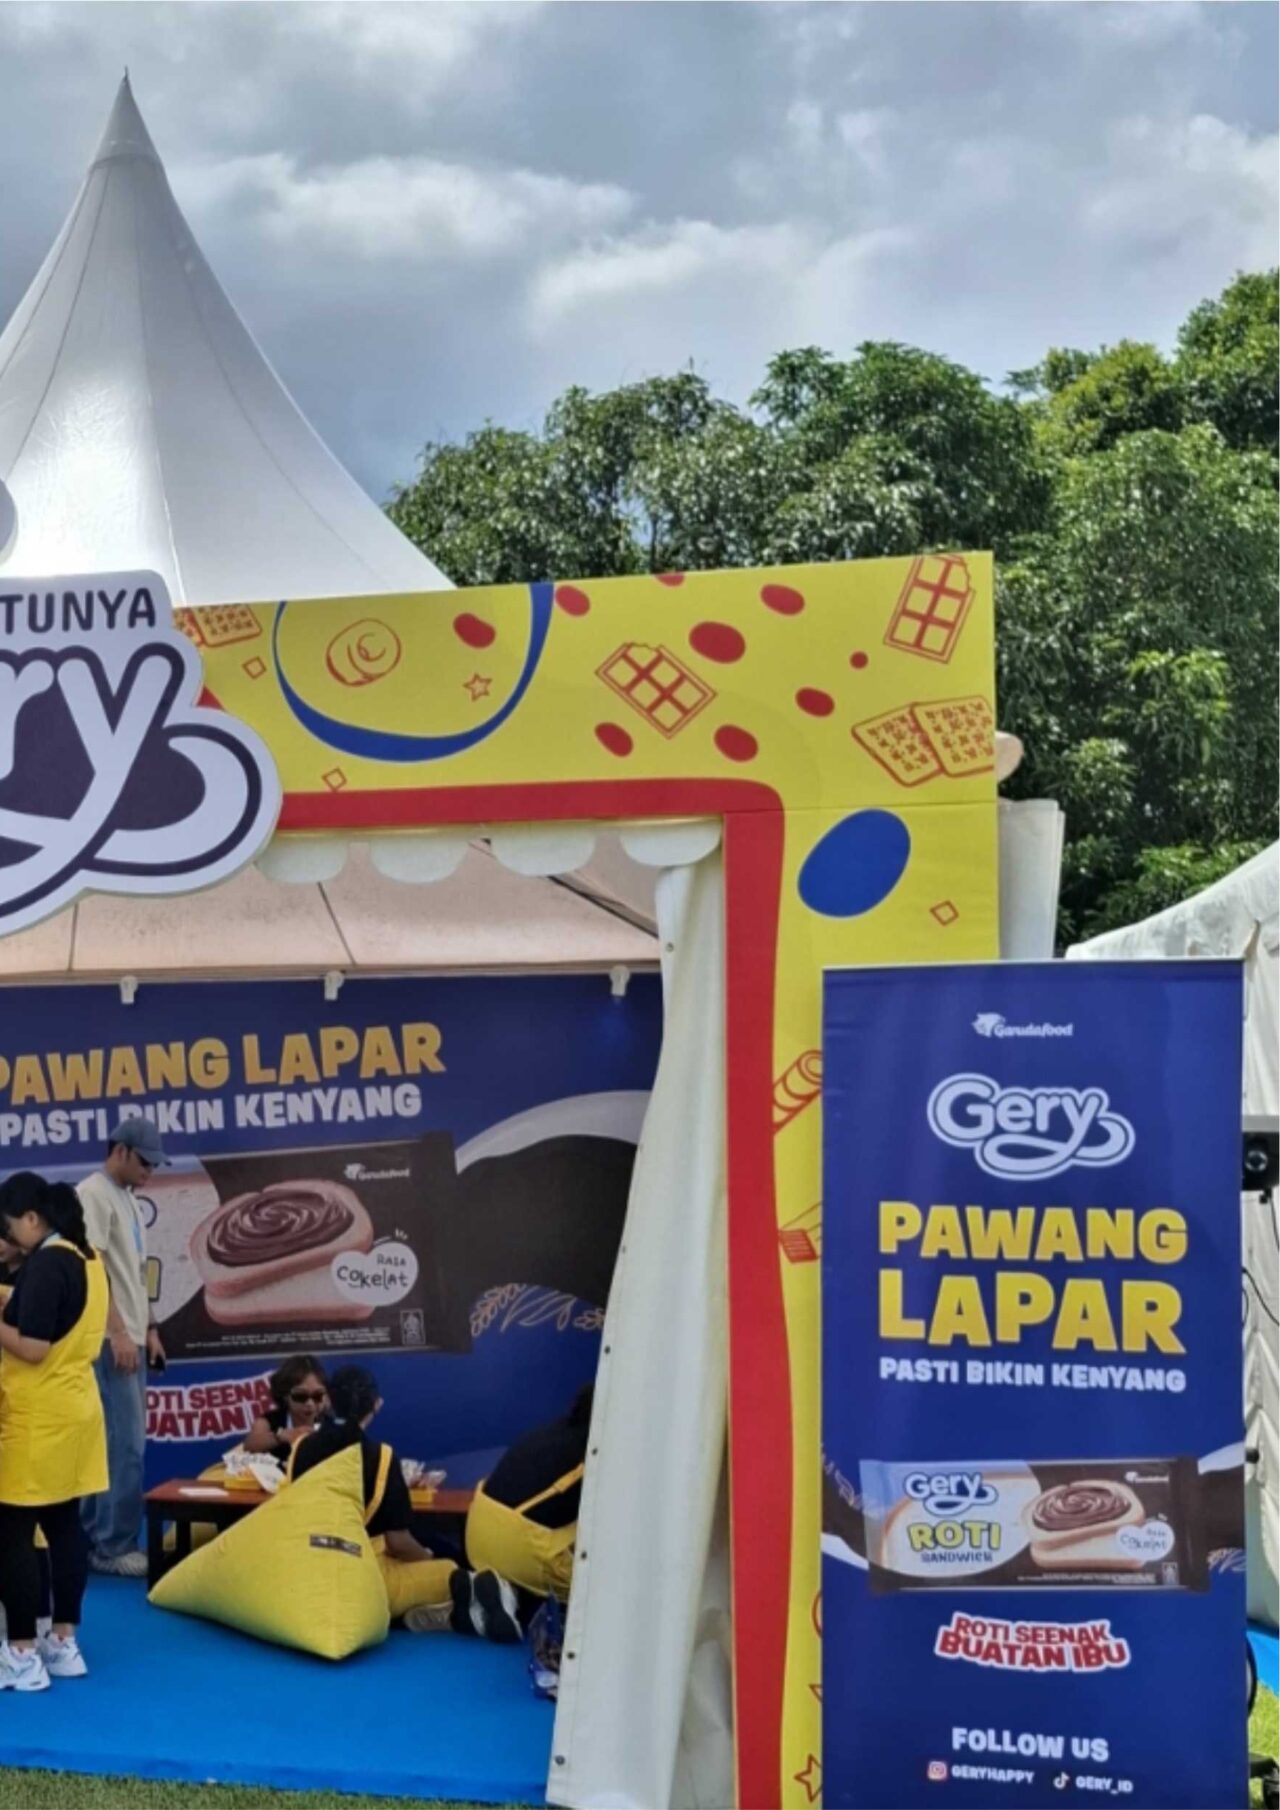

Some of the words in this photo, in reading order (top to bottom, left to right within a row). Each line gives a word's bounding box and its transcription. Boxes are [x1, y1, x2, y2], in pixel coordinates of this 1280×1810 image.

[993, 1022, 1074, 1039] Garudafood
[243, 1022, 447, 1086] LAPAR
[236, 1083, 422, 1130] KENYANG
[928, 1073, 1135, 1181] Gery
[879, 1201, 1188, 1264] PAWANG
[879, 1269, 1187, 1354] LAPAR
[879, 1357, 959, 1383] PASTI
[966, 1360, 1044, 1385] BIKIN
[1051, 1363, 1187, 1392] KENYANG
[145, 1389, 185, 1410] OTI
[189, 1377, 275, 1410] SEENA
[145, 1405, 247, 1437] UATAN
[903, 1471, 999, 1517] Gery
[907, 1520, 1001, 1552] ROTI
[955, 1616, 1010, 1641] ROTI
[1015, 1623, 1110, 1644] SEENAK
[939, 1631, 1065, 1667] BUATAN
[1073, 1641, 1126, 1669] IBU
[952, 1727, 1064, 1759] FOLLOW
[1072, 1737, 1110, 1763] US
[951, 1764, 1035, 1784] GERYHAPPY
[1075, 1776, 1134, 1795] GERY_ID
